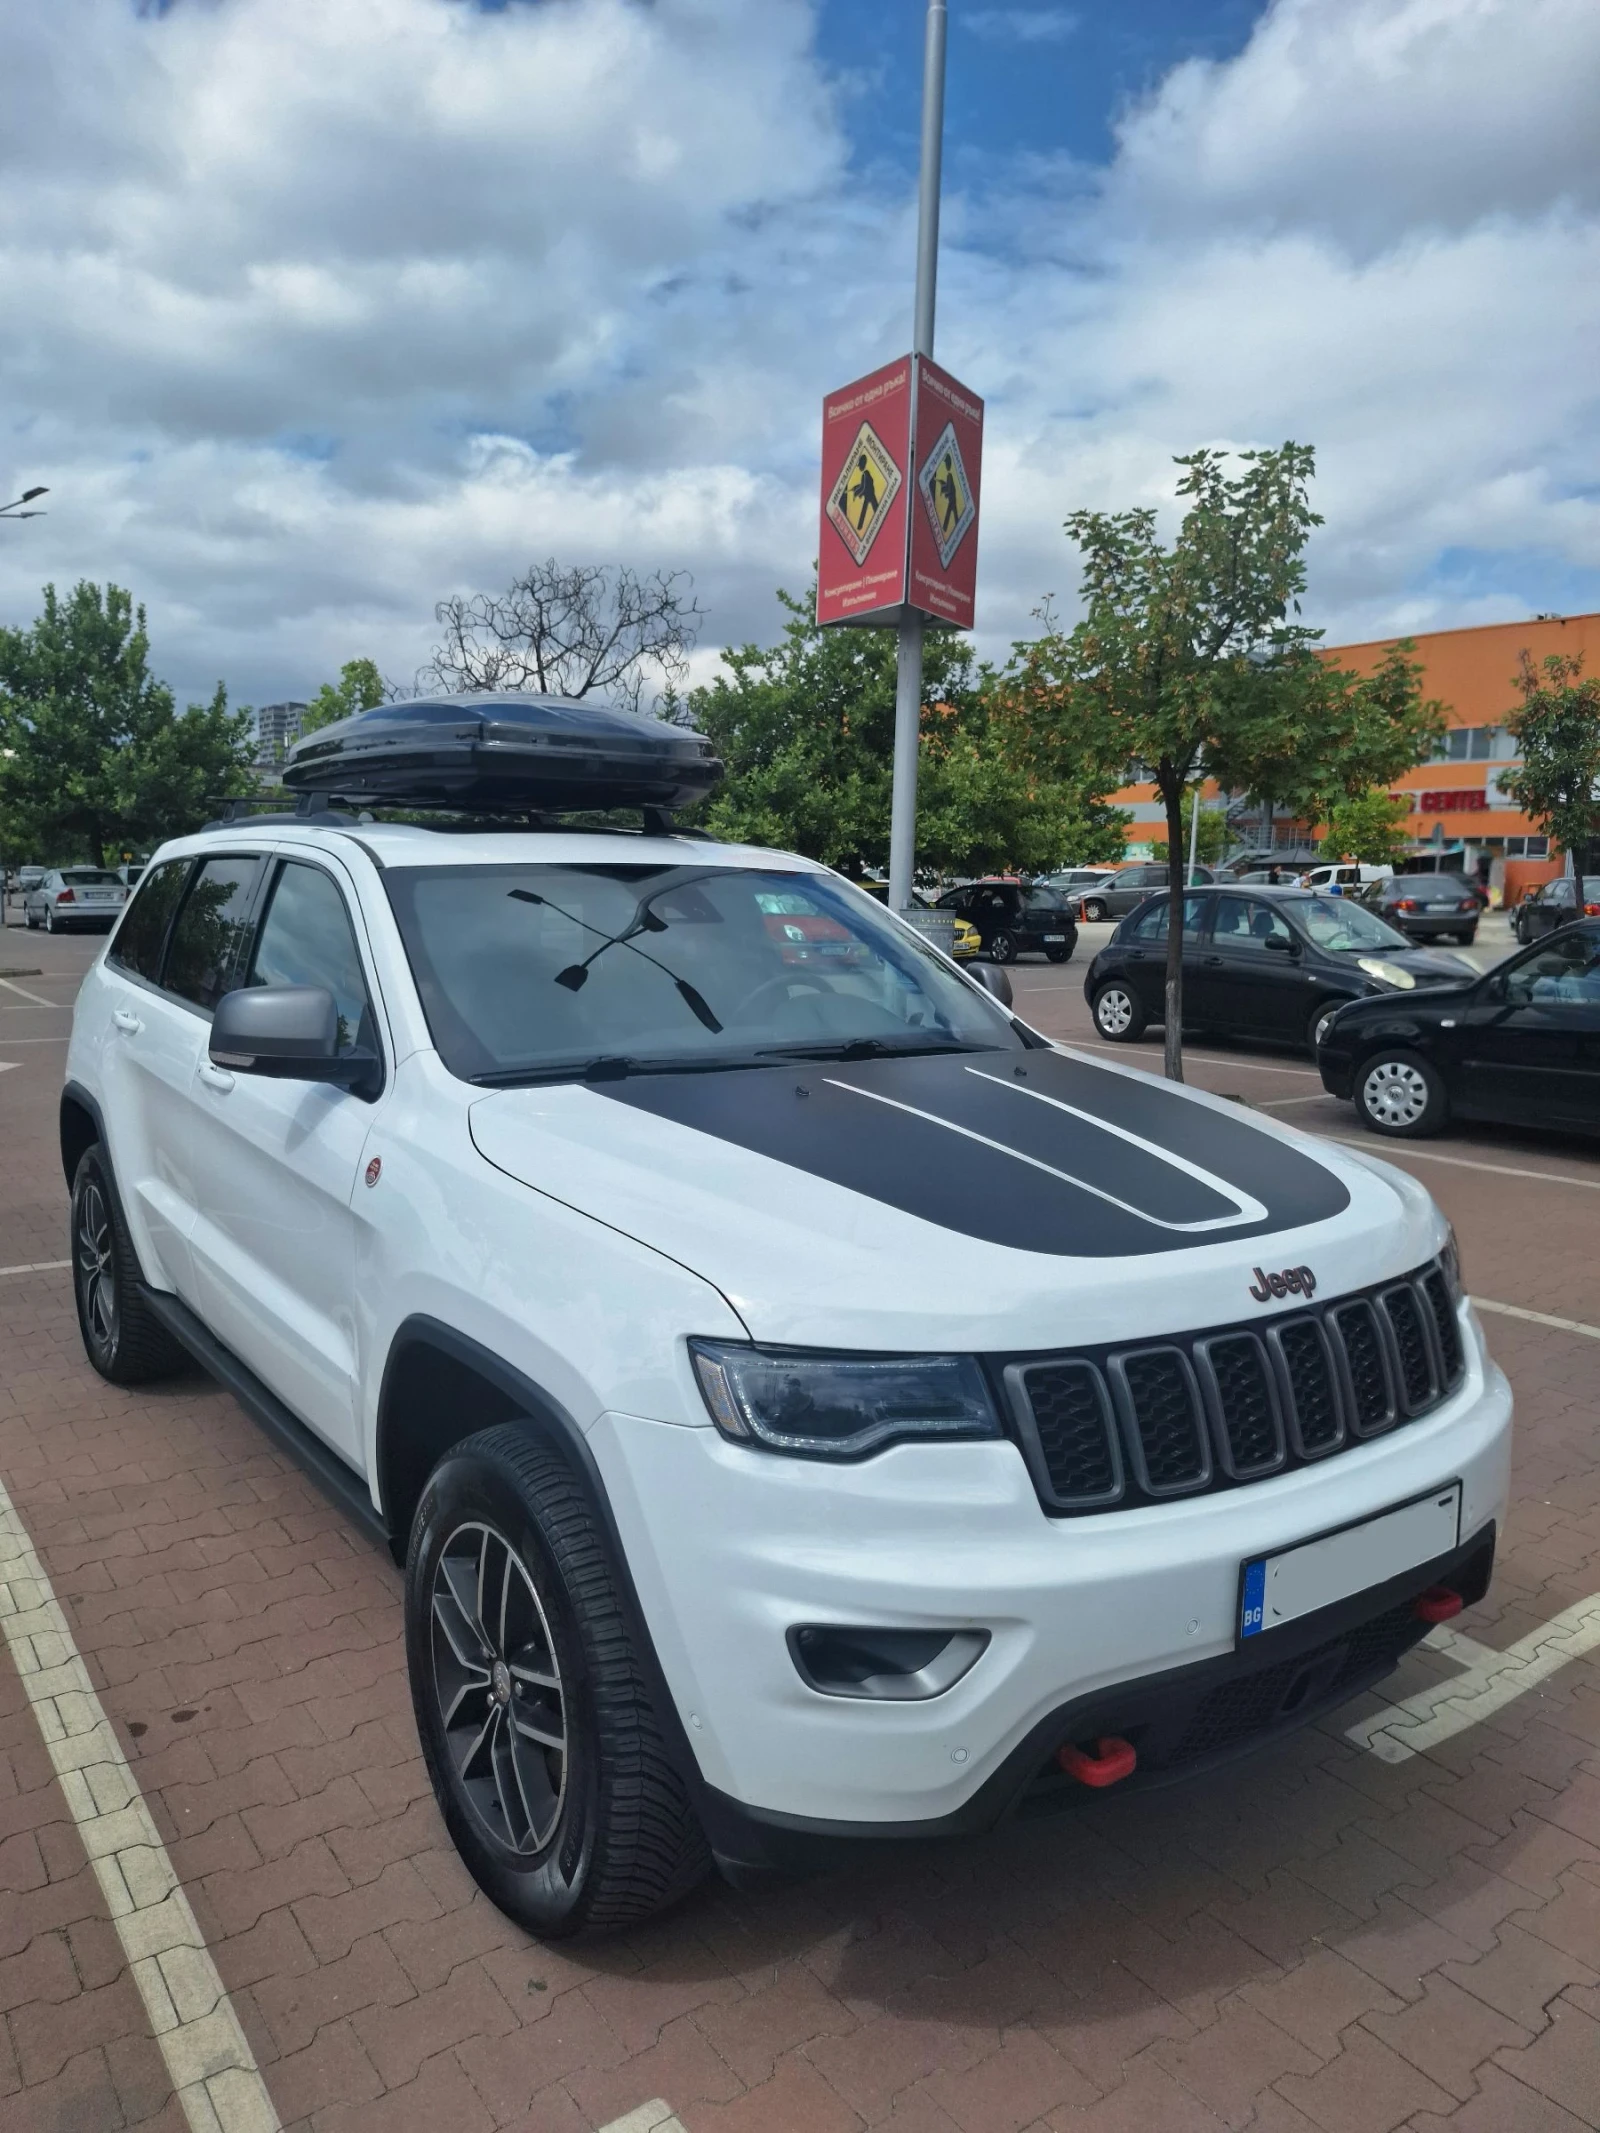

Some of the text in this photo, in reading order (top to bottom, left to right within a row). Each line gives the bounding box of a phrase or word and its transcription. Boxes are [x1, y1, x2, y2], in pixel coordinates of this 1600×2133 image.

[866, 434, 894, 479] МОНТИРАНЕ
[1249, 1266, 1317, 1302] Jeep
[1244, 1606, 1261, 1627] BG
